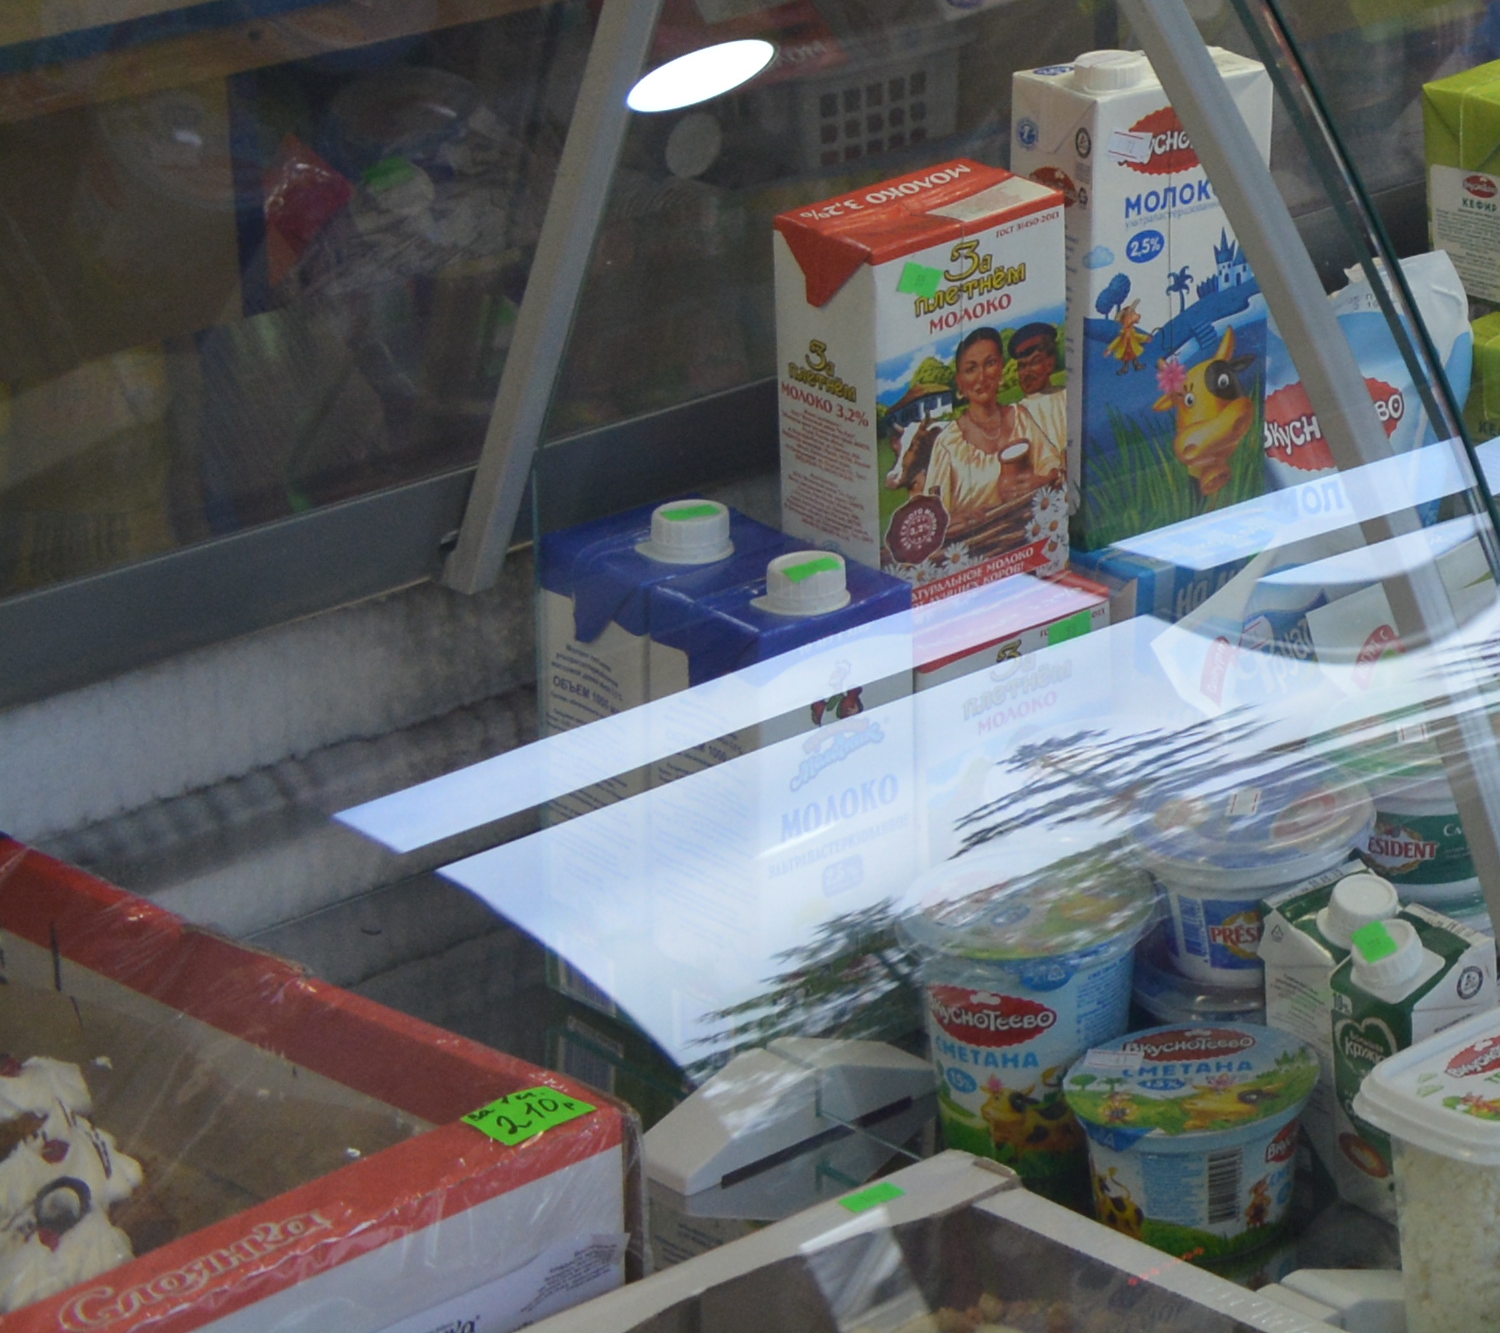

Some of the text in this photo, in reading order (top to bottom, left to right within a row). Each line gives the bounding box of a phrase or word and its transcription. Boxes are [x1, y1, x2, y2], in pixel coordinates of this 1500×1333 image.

[1130, 237, 1162, 258] 2,5%
[929, 292, 1013, 335] МОЛОКО
[780, 382, 832, 415] МОЛОКО
[1122, 1060, 1253, 1079] СМЕТАНА
